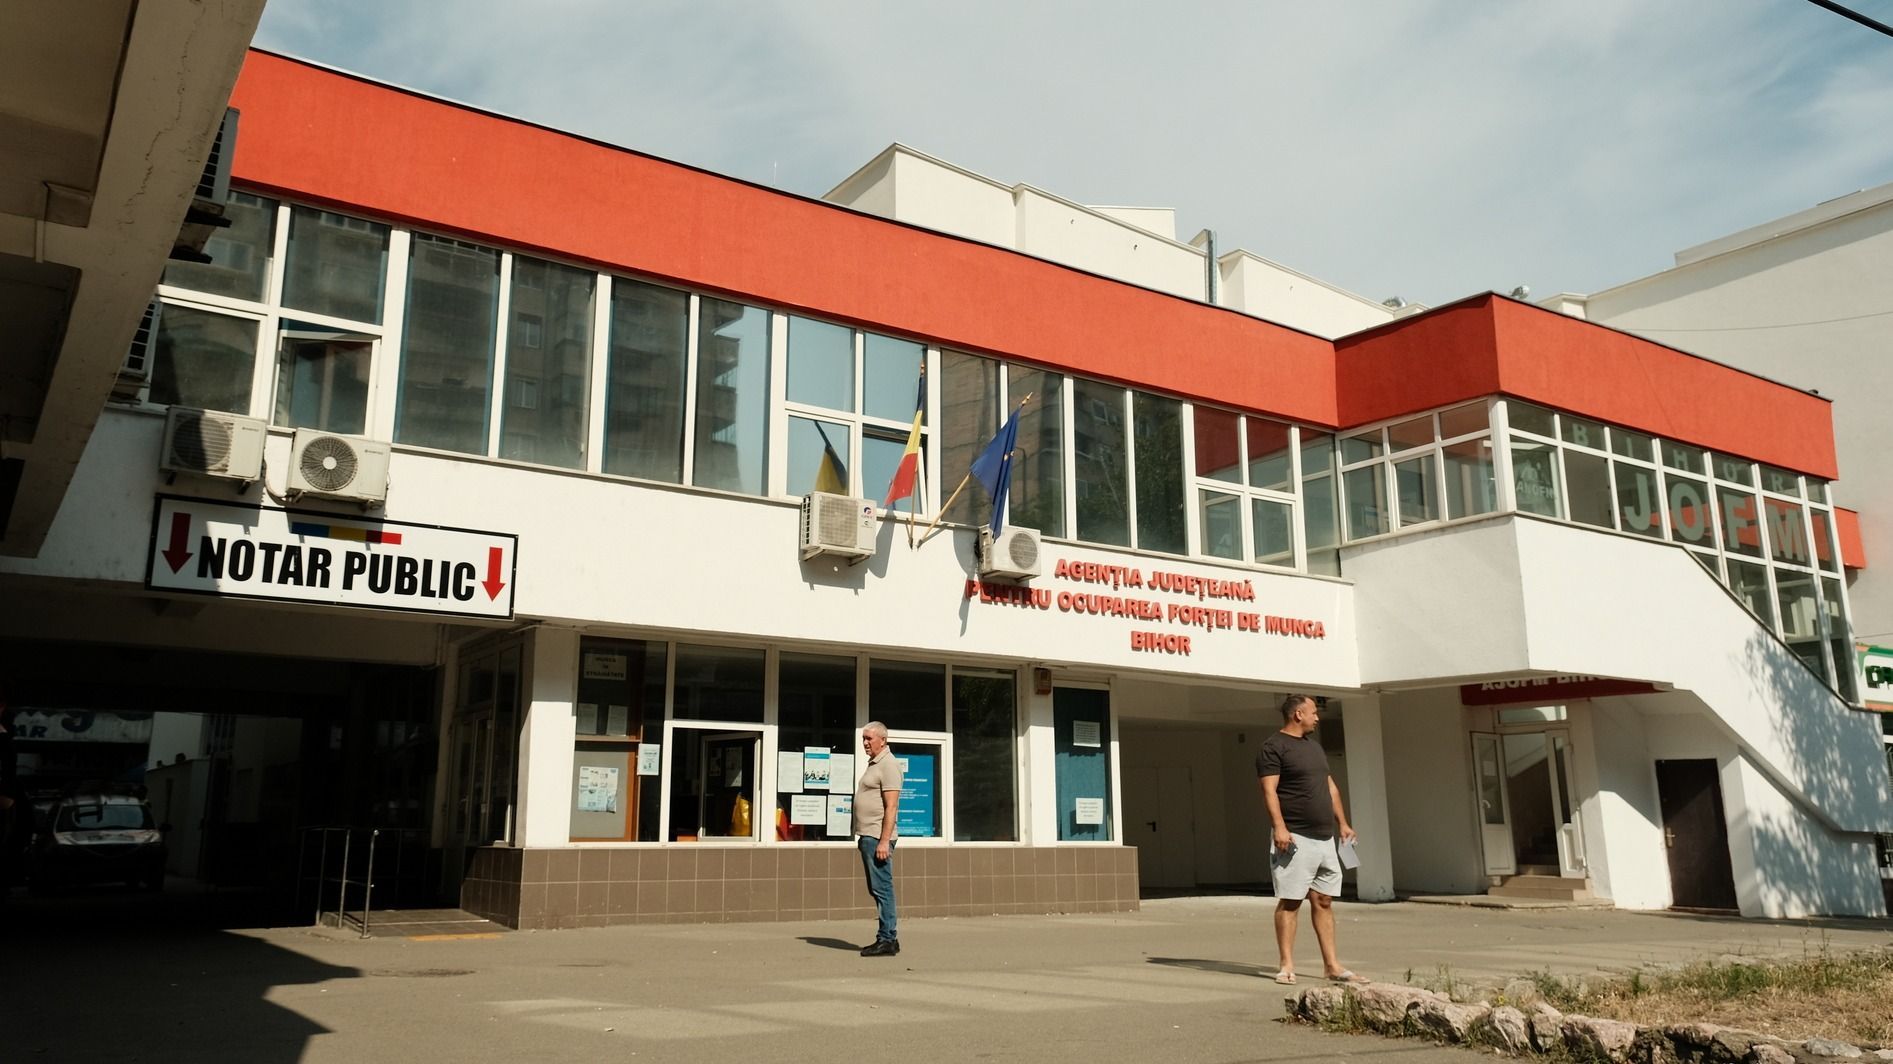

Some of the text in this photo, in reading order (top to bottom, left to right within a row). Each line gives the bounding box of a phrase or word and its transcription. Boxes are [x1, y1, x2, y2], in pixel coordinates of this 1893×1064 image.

[198, 536, 476, 601] NOTAR PUBLIC
[966, 579, 1051, 609] PENTRU
[1057, 591, 1163, 622] OCUPAREA
[1238, 613, 1260, 632] DE
[1265, 615, 1325, 639] MUNCA
[1131, 631, 1191, 656] BIHOR
